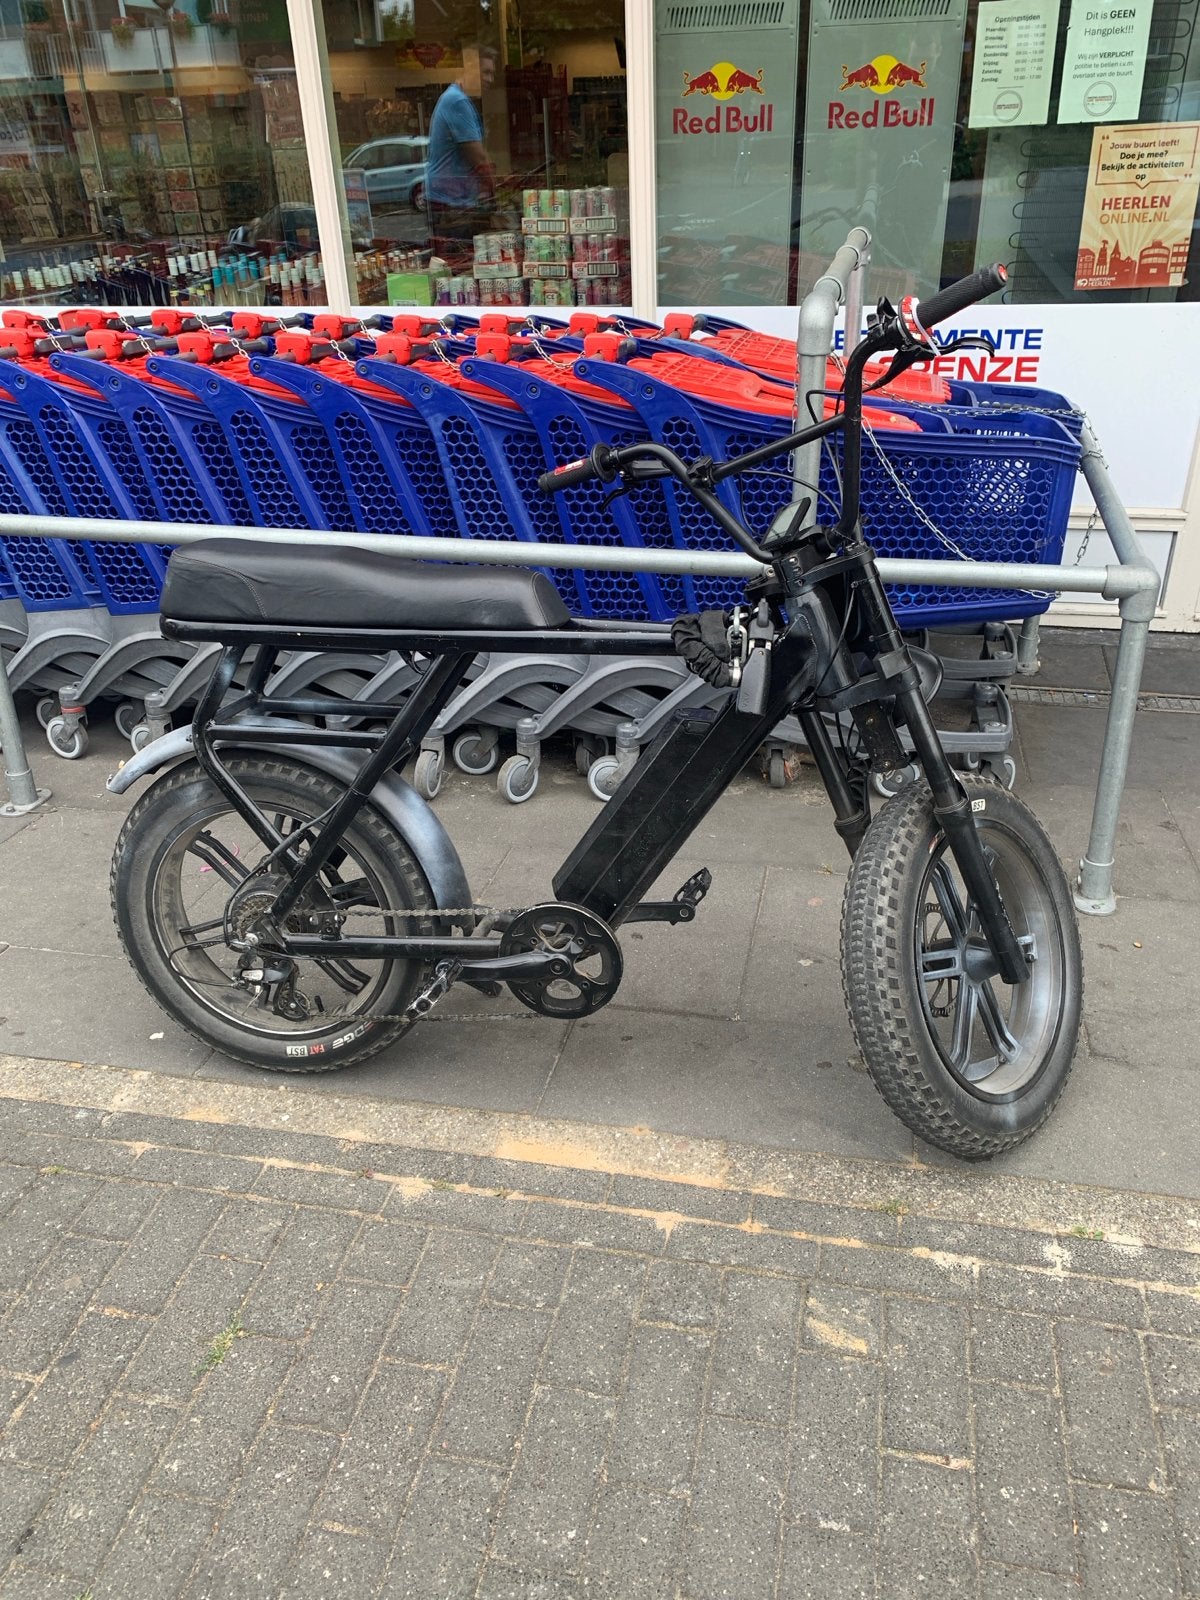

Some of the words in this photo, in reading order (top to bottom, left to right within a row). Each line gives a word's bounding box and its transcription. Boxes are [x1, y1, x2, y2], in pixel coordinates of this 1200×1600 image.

[994, 14, 1040, 23] Openingstijden
[1086, 12, 1098, 20] Dit
[1100, 12, 1108, 20] is
[1110, 8, 1136, 19] GEEN
[1084, 25, 1134, 37] Hangplek!!!
[1099, 50, 1134, 59] VERPLICHT
[1100, 60, 1118, 68] bellen
[672, 105, 721, 134] Red
[726, 103, 773, 133] Bull
[827, 100, 880, 129] Red
[883, 97, 935, 128] Bull
[1110, 142, 1132, 150] Jouw
[1133, 140, 1156, 148] buurt
[1158, 139, 1180, 147] leeft!
[1120, 152, 1136, 160] Doe
[1137, 151, 1145, 160] je
[1146, 150, 1168, 158] mee?
[1101, 163, 1125, 172] Bekijk
[1127, 162, 1137, 170] de
[1138, 160, 1185, 169] activiteiten
[1135, 173, 1146, 181] op
[1101, 195, 1172, 211] HEERLEN
[1100, 211, 1170, 225] ONLINE.NL
[972, 800, 984, 811] BST
[288, 1047, 306, 1056] BST
[309, 1044, 325, 1055] FAT
